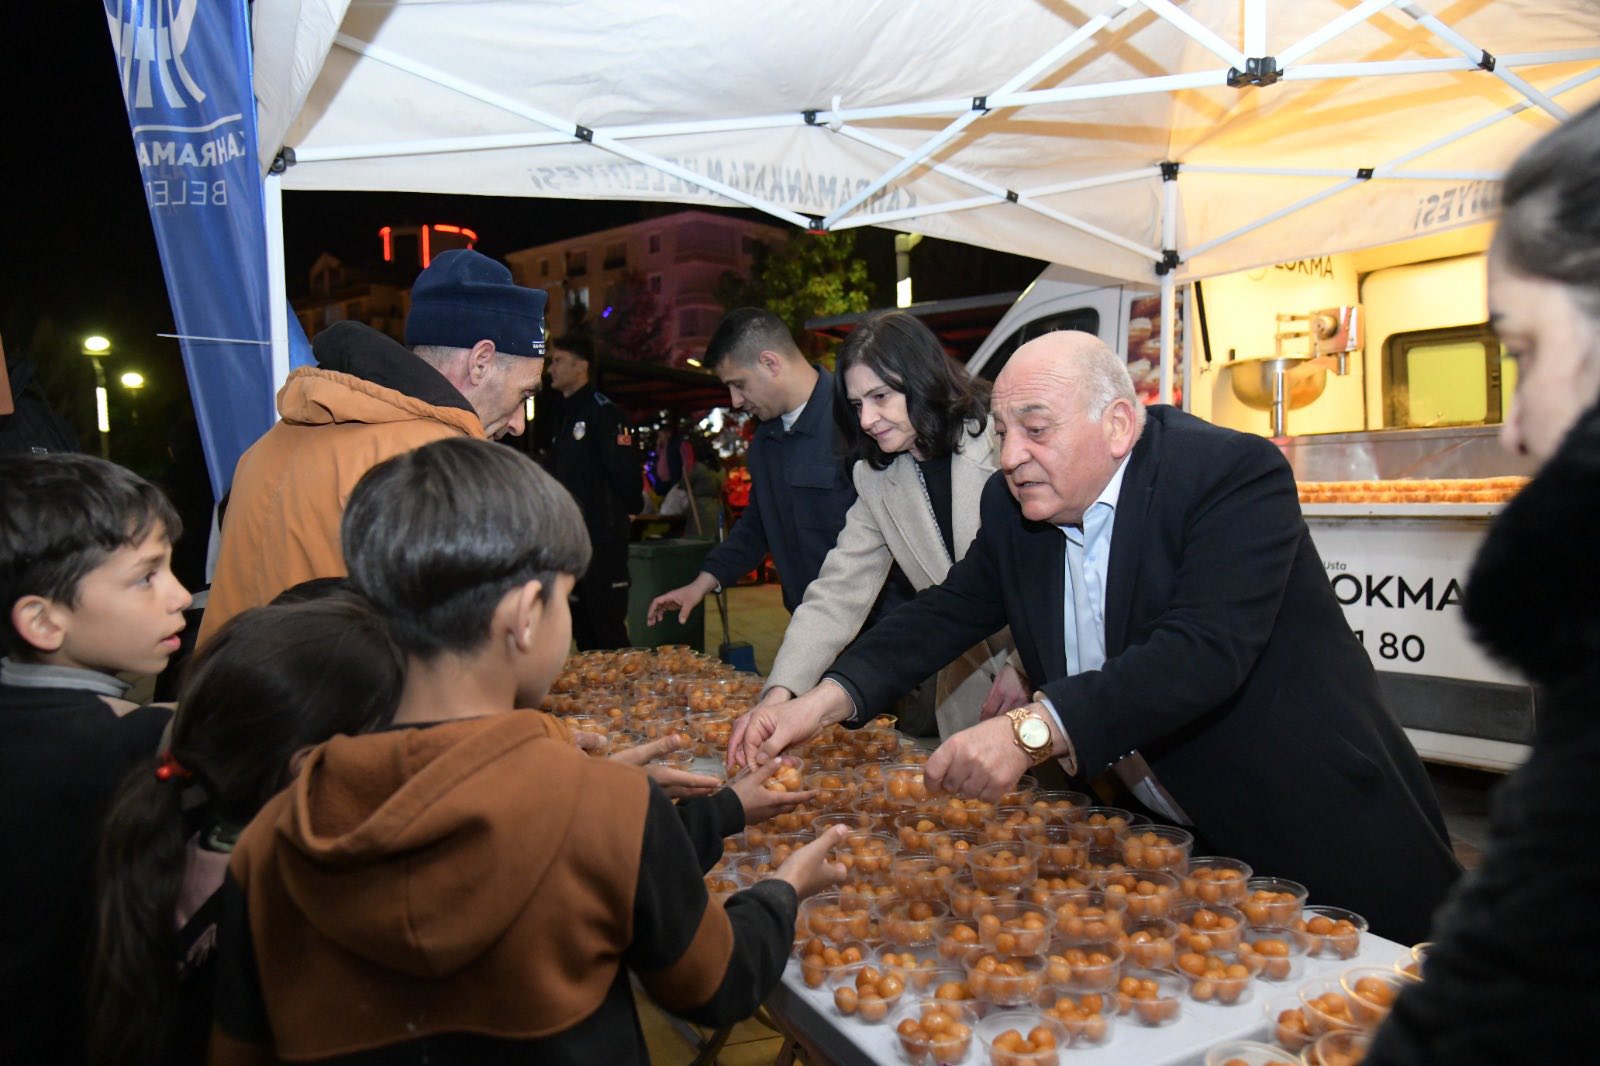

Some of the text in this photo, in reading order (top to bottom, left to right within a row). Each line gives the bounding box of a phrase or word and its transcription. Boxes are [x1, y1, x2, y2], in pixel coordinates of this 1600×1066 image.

[1275, 256, 1334, 280] OKMA
[1331, 573, 1465, 611] OKMA
[1378, 632, 1425, 662] 80
